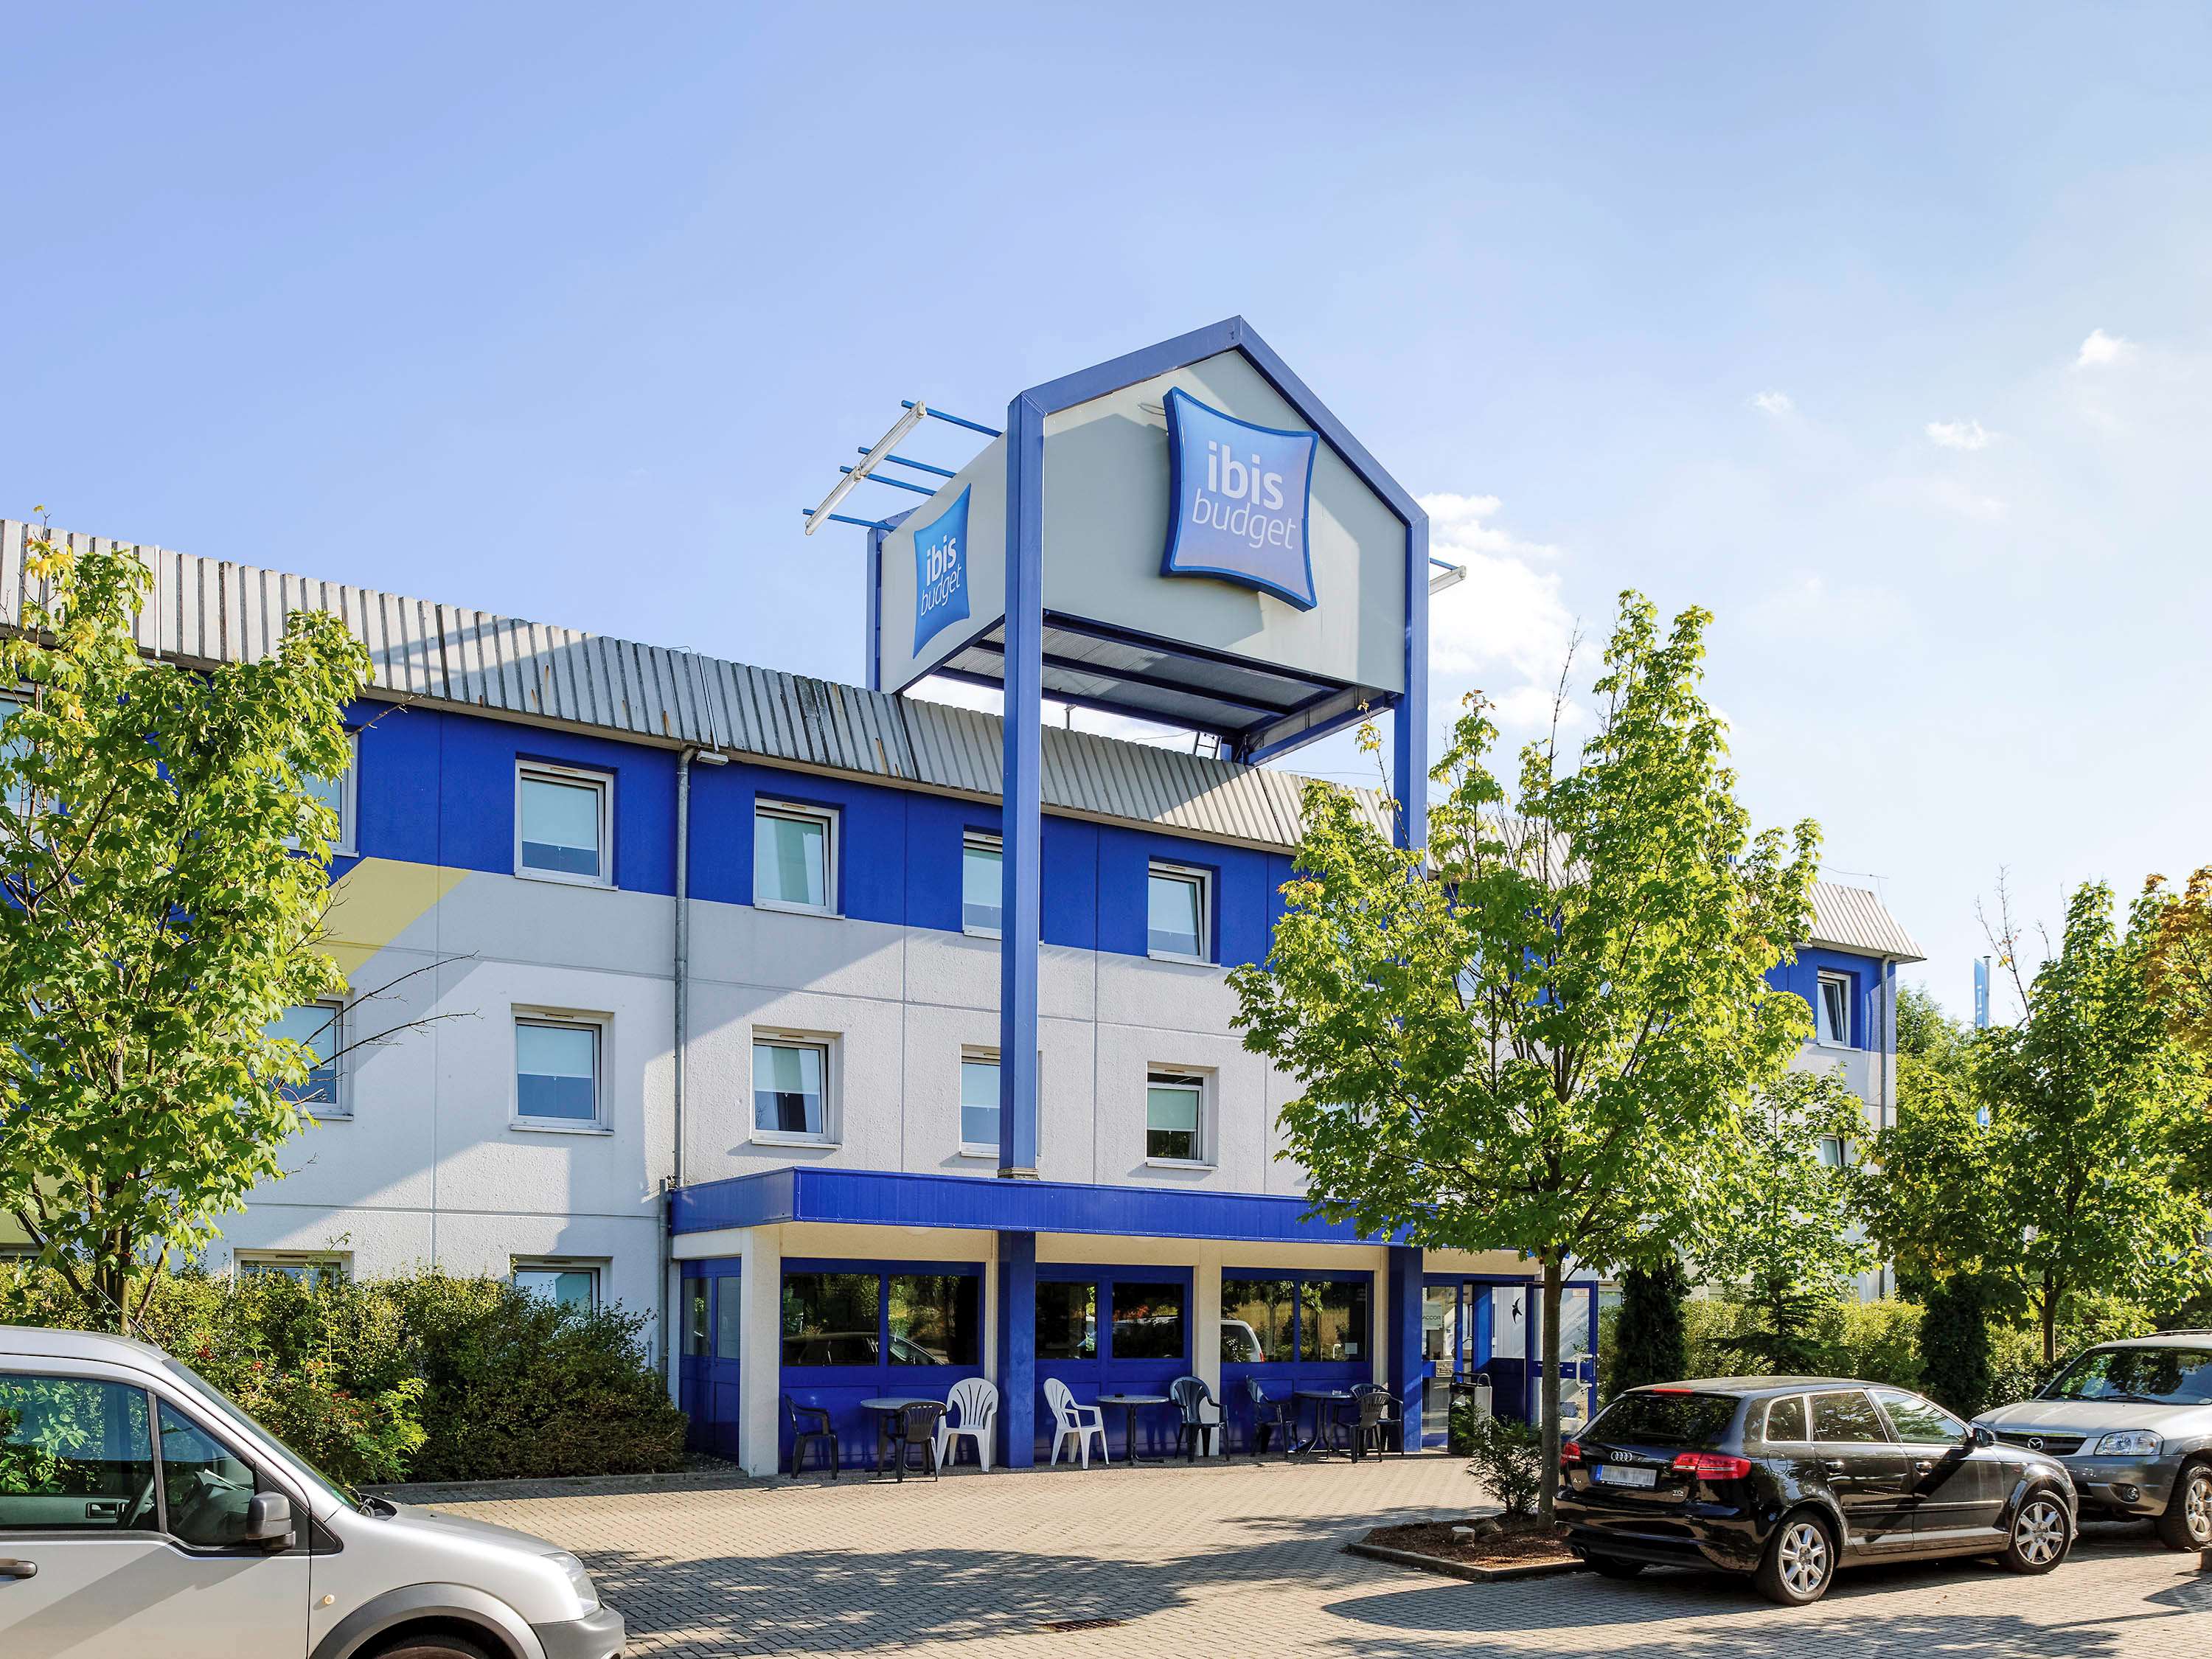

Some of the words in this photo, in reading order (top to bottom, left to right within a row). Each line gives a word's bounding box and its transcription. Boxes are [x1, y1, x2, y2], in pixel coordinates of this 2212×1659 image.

[1208, 440, 1284, 510] ibis
[1192, 487, 1295, 549] budget
[926, 535, 956, 586] ibis
[921, 563, 961, 616] budget
